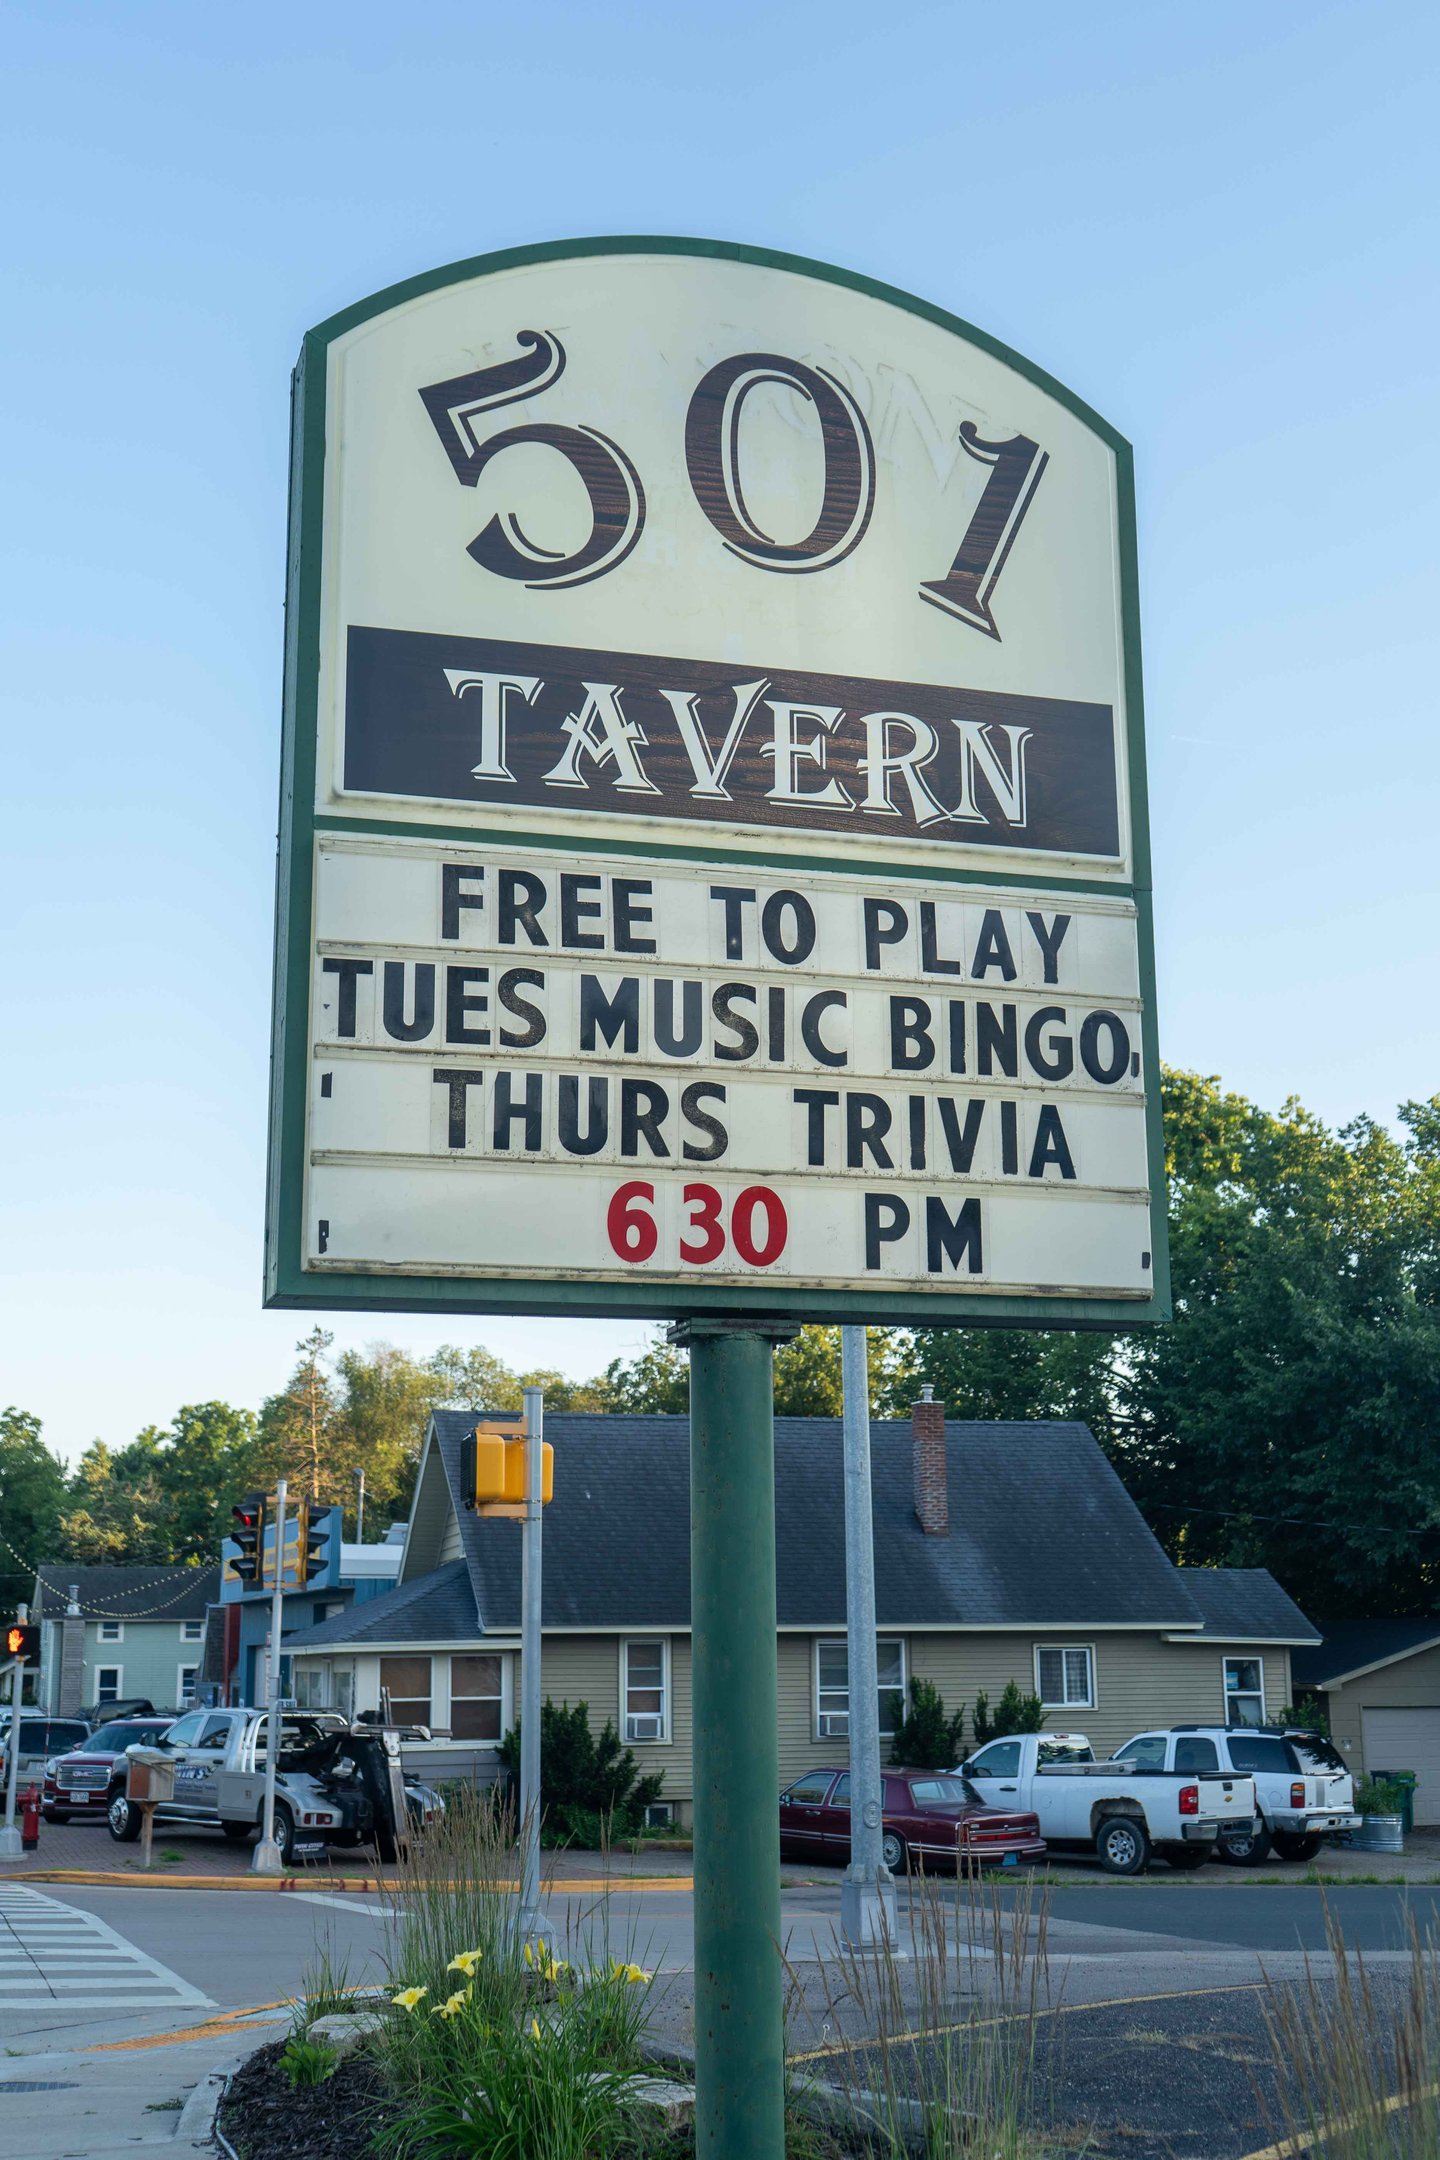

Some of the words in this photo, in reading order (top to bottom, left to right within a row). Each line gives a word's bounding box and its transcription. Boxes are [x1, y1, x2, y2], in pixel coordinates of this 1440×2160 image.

[418, 329, 1050, 642] 501
[443, 668, 1034, 829] TAVERN
[442, 864, 657, 954] FREE
[710, 886, 816, 965] TO
[864, 898, 1071, 984] PLAY
[322, 957, 547, 1048] TUES
[580, 974, 848, 1067] MUSIC
[889, 995, 1131, 1085] BINGO
[433, 1068, 729, 1161] THURS
[793, 1088, 1077, 1179] TRIVIA
[865, 1193, 983, 1274] PM
